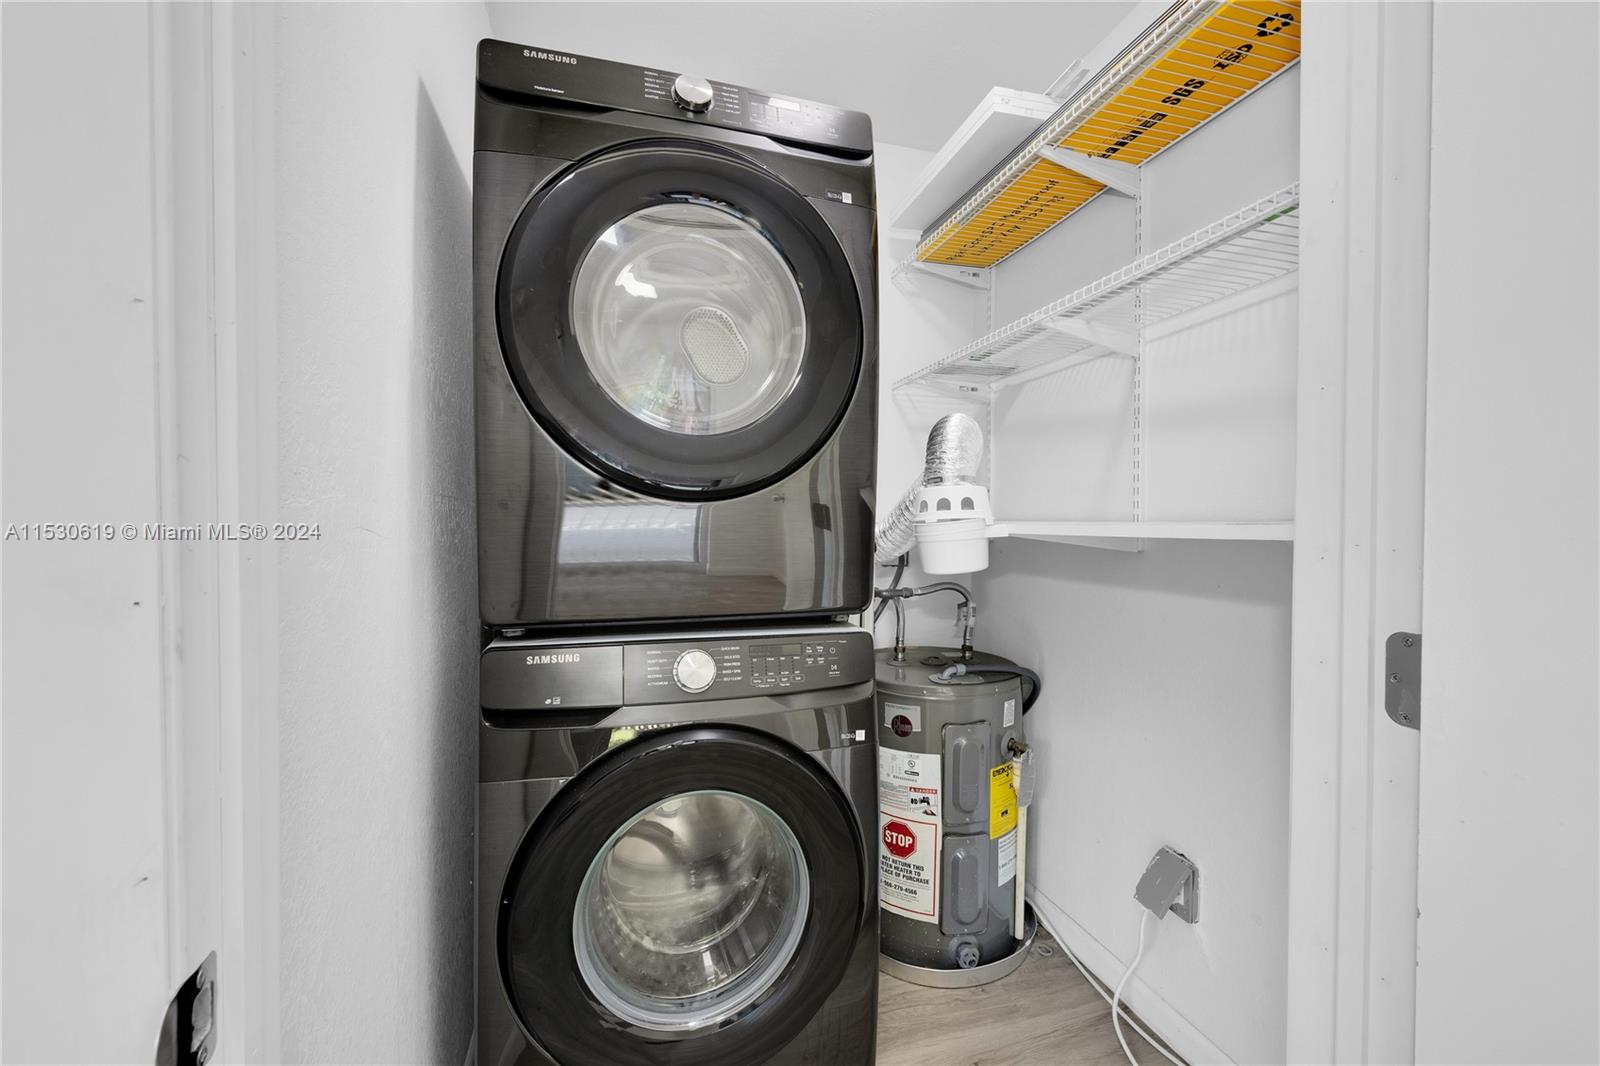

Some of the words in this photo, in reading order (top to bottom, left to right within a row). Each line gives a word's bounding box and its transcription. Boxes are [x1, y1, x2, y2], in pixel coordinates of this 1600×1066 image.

[523, 49, 577, 65] SAMSUNG
[1213, 44, 1253, 70] ISO
[1161, 78, 1206, 106] SGS
[526, 653, 580, 665] SAMSUNG
[885, 830, 913, 848] STOP
[880, 860, 893, 869] ATER
[893, 865, 913, 875] HEATER
[881, 854, 891, 863] NOT
[891, 859, 911, 869] RETURN
[913, 864, 925, 872] THIS
[902, 874, 929, 885] PURCHASE
